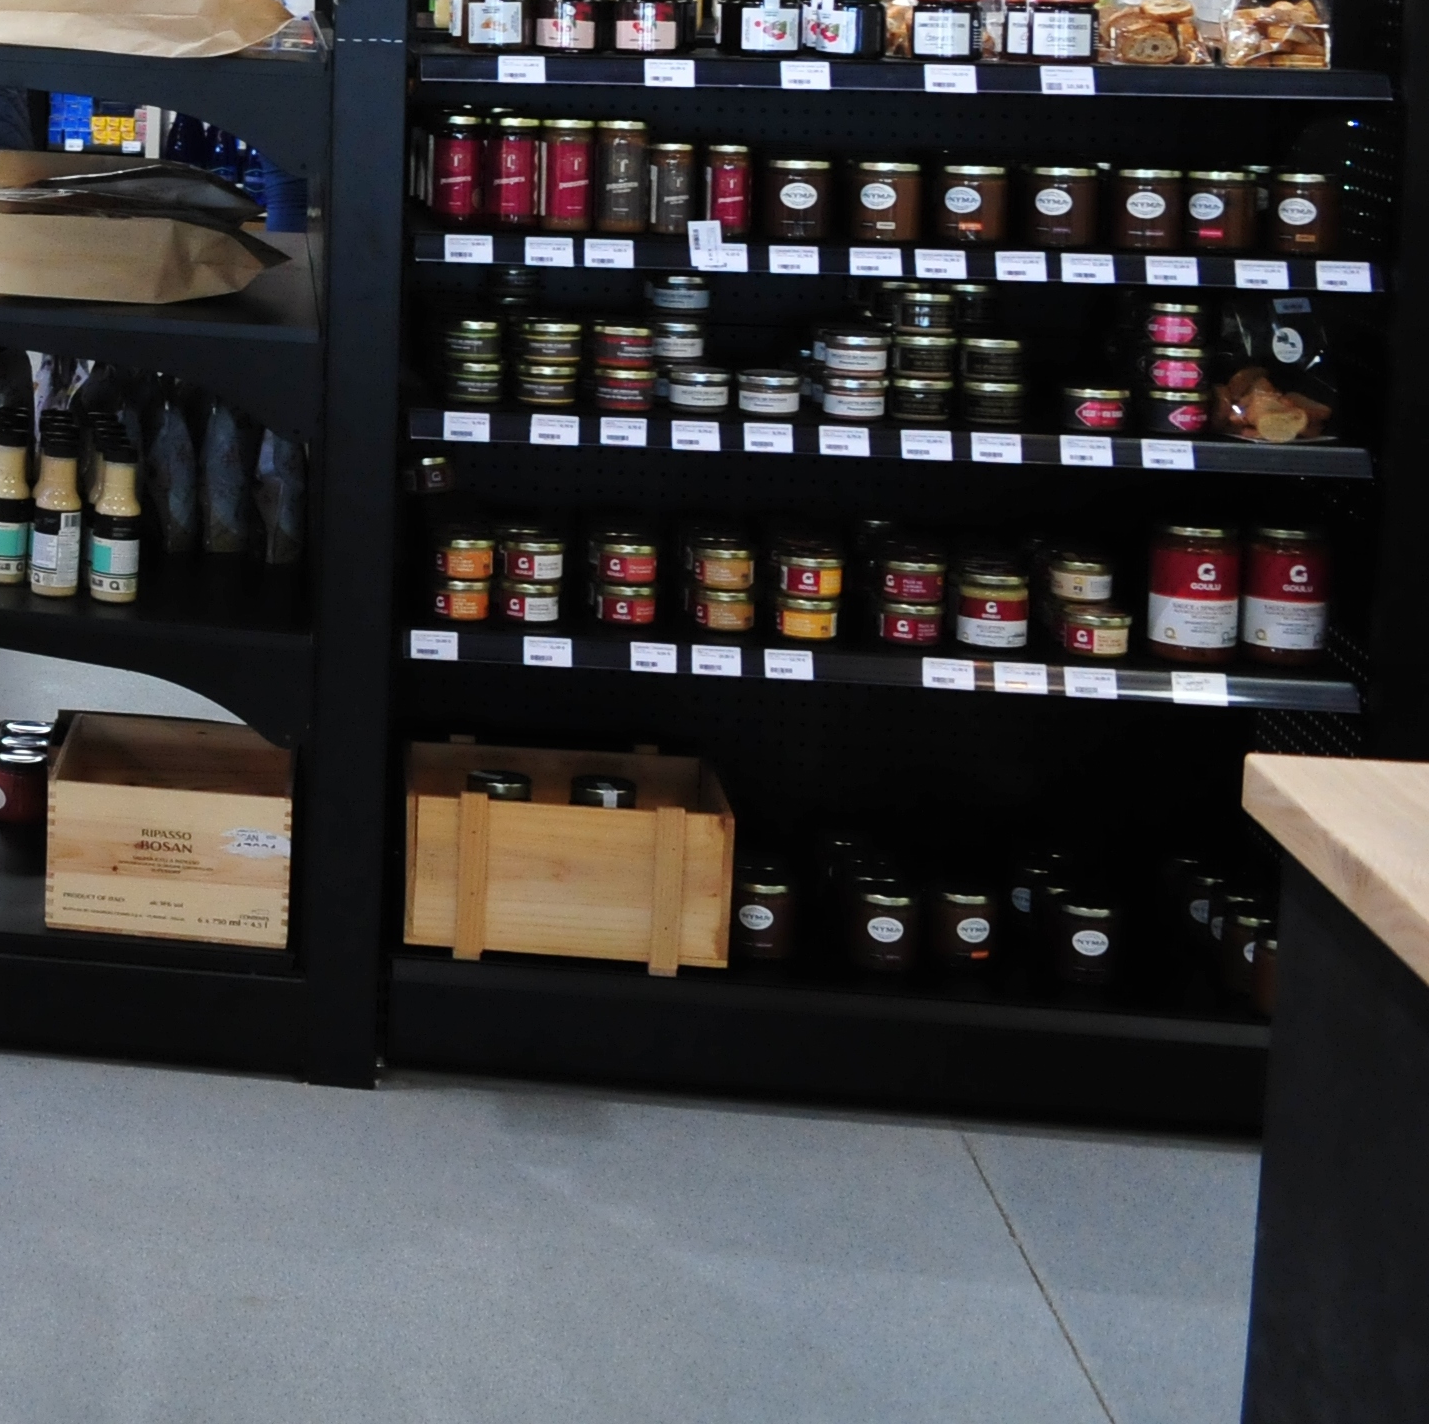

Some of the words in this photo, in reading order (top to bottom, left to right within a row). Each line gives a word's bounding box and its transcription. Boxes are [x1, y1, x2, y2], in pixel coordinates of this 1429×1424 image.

[1190, 202, 1221, 210] NYMA
[1190, 582, 1222, 591] GOULU
[1282, 584, 1314, 593] GOULU
[141, 828, 193, 840] RIPASSO
[140, 840, 193, 854] BOSAN
[62, 892, 97, 901] PRODUCT
[107, 895, 126, 903] ITALY
[741, 912, 771, 920] NYMA
[871, 924, 902, 932] NYMA
